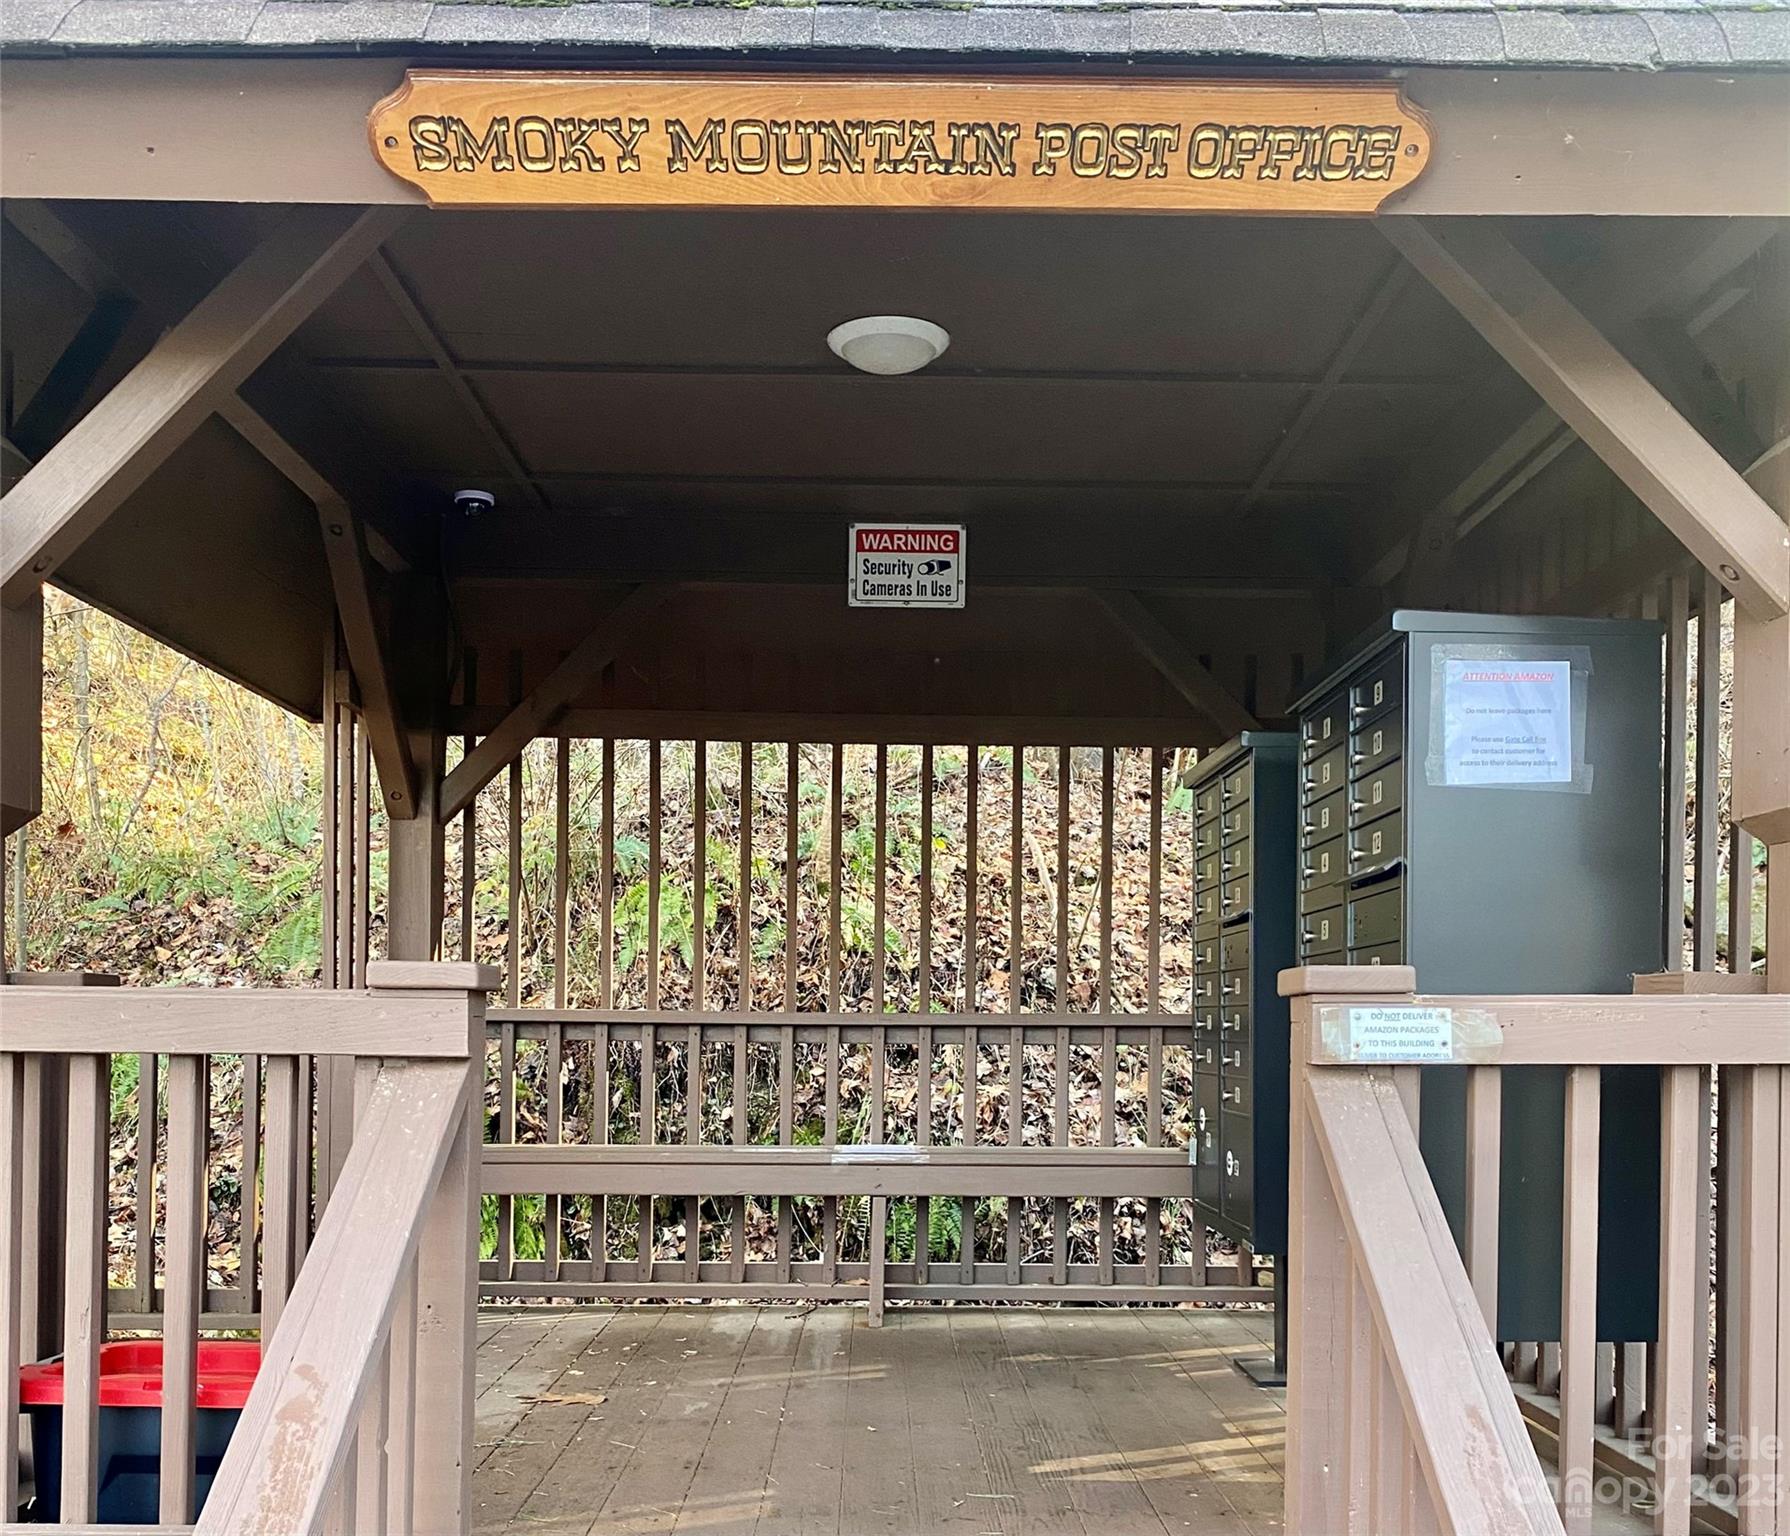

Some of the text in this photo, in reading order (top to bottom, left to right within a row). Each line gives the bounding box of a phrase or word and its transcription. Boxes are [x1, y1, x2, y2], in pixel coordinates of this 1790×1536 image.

[408, 115, 1401, 182] SMOKY MOUNTAIN POST OFFICE
[862, 533, 954, 551] WARNING
[862, 558, 914, 579] Security
[862, 579, 913, 597] Cameras
[916, 580, 928, 597] In
[931, 581, 952, 597] Use
[1463, 672, 1554, 682] ATTENTION AMAZON
[1370, 1012, 1433, 1021] DO NOT DELIVER
[1364, 1026, 1440, 1034] AMAZON PACKAGES
[1368, 1039, 1435, 1047] TO THIS BUILDING
